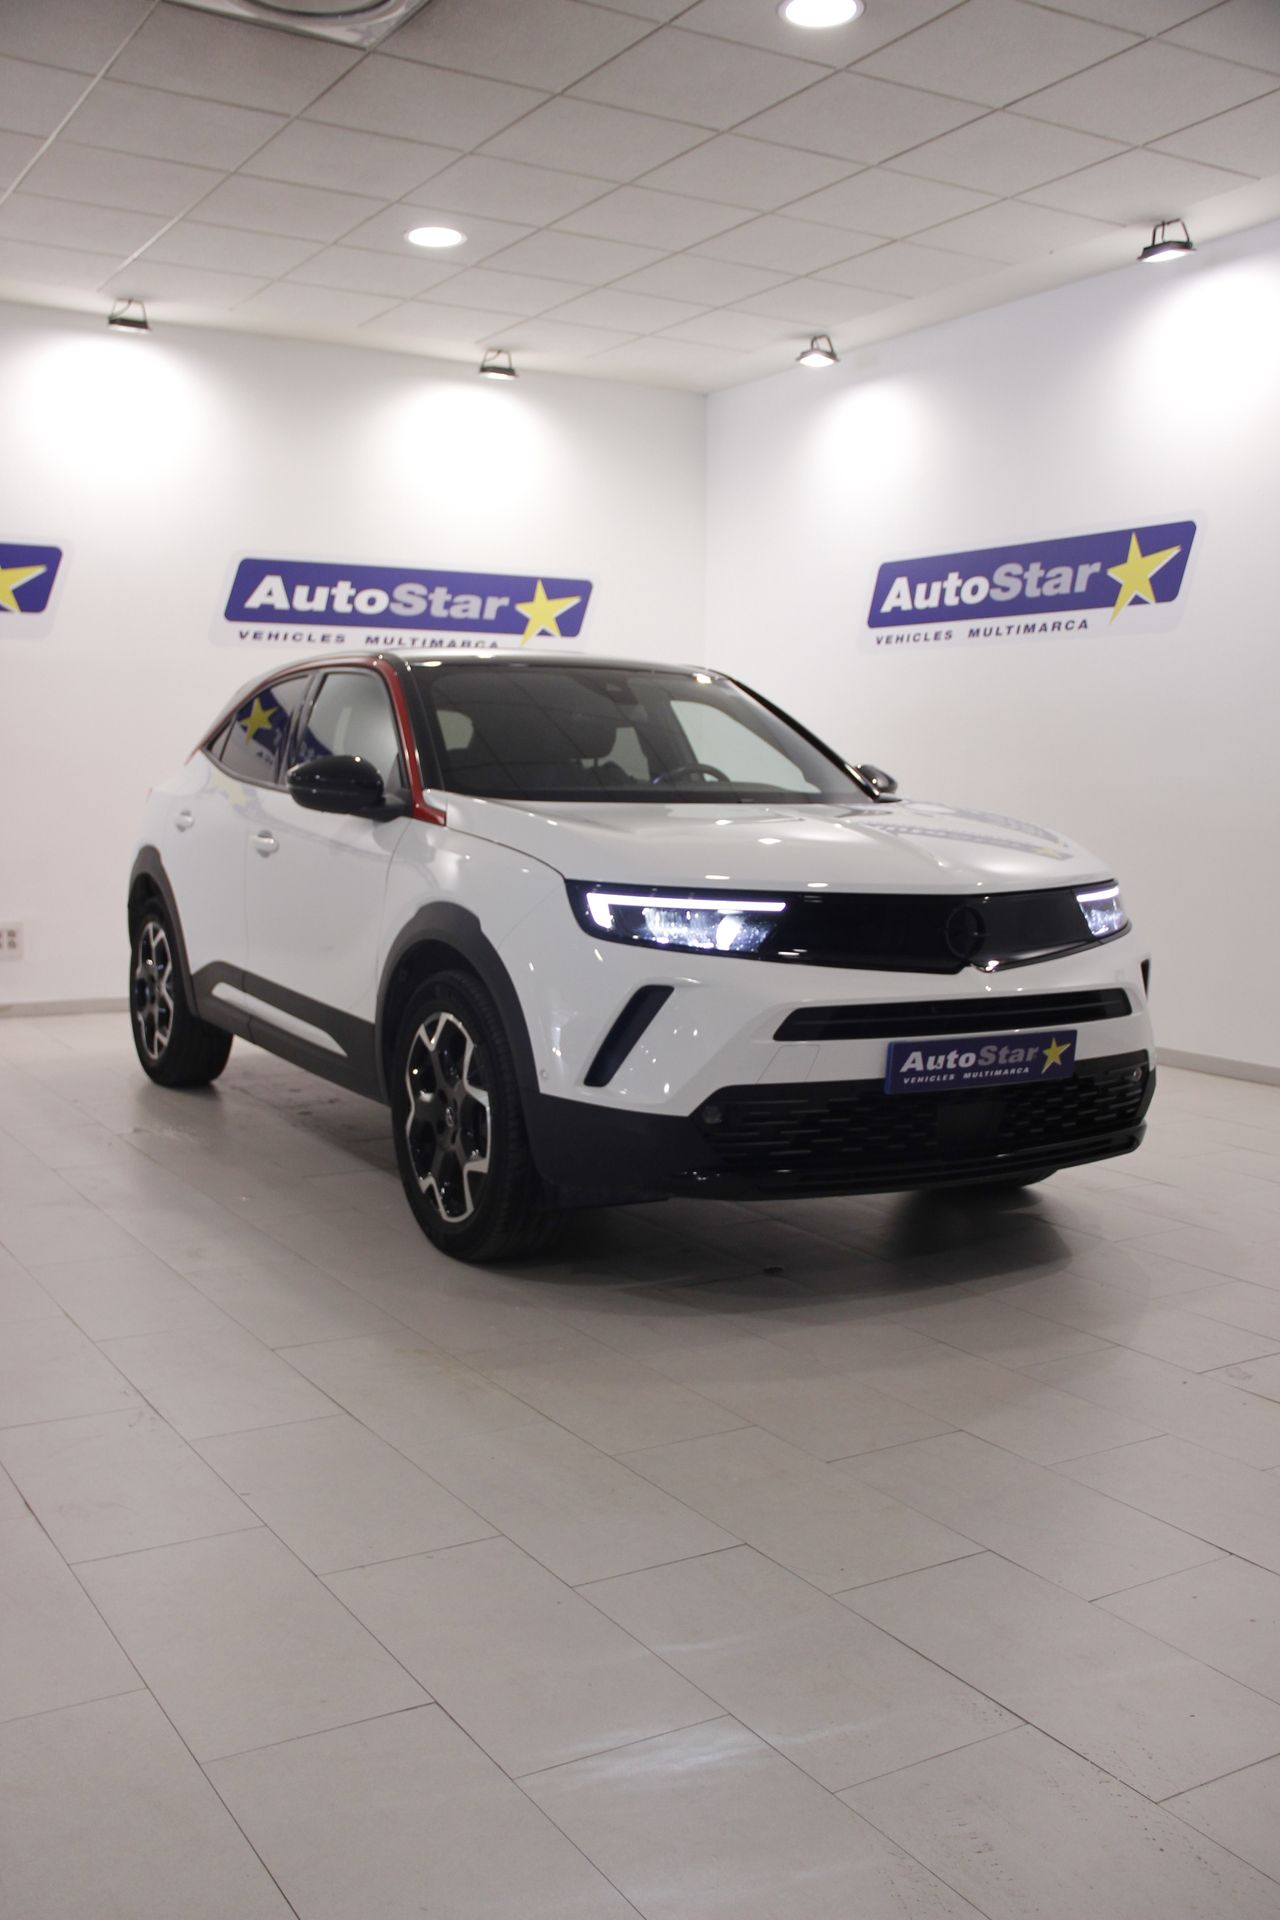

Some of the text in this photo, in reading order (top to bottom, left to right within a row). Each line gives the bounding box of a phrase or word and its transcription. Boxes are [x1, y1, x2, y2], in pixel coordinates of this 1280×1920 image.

[244, 574, 510, 621] AutoStar
[880, 561, 1102, 614] AutoStar
[238, 630, 498, 649] VEHICLES MULTIMARCA
[875, 619, 1089, 645] VEHICLES MULTIMARCA
[900, 1045, 1040, 1073] AutoStar
[903, 1066, 1030, 1085] VEHICLES MULTIMARCA
